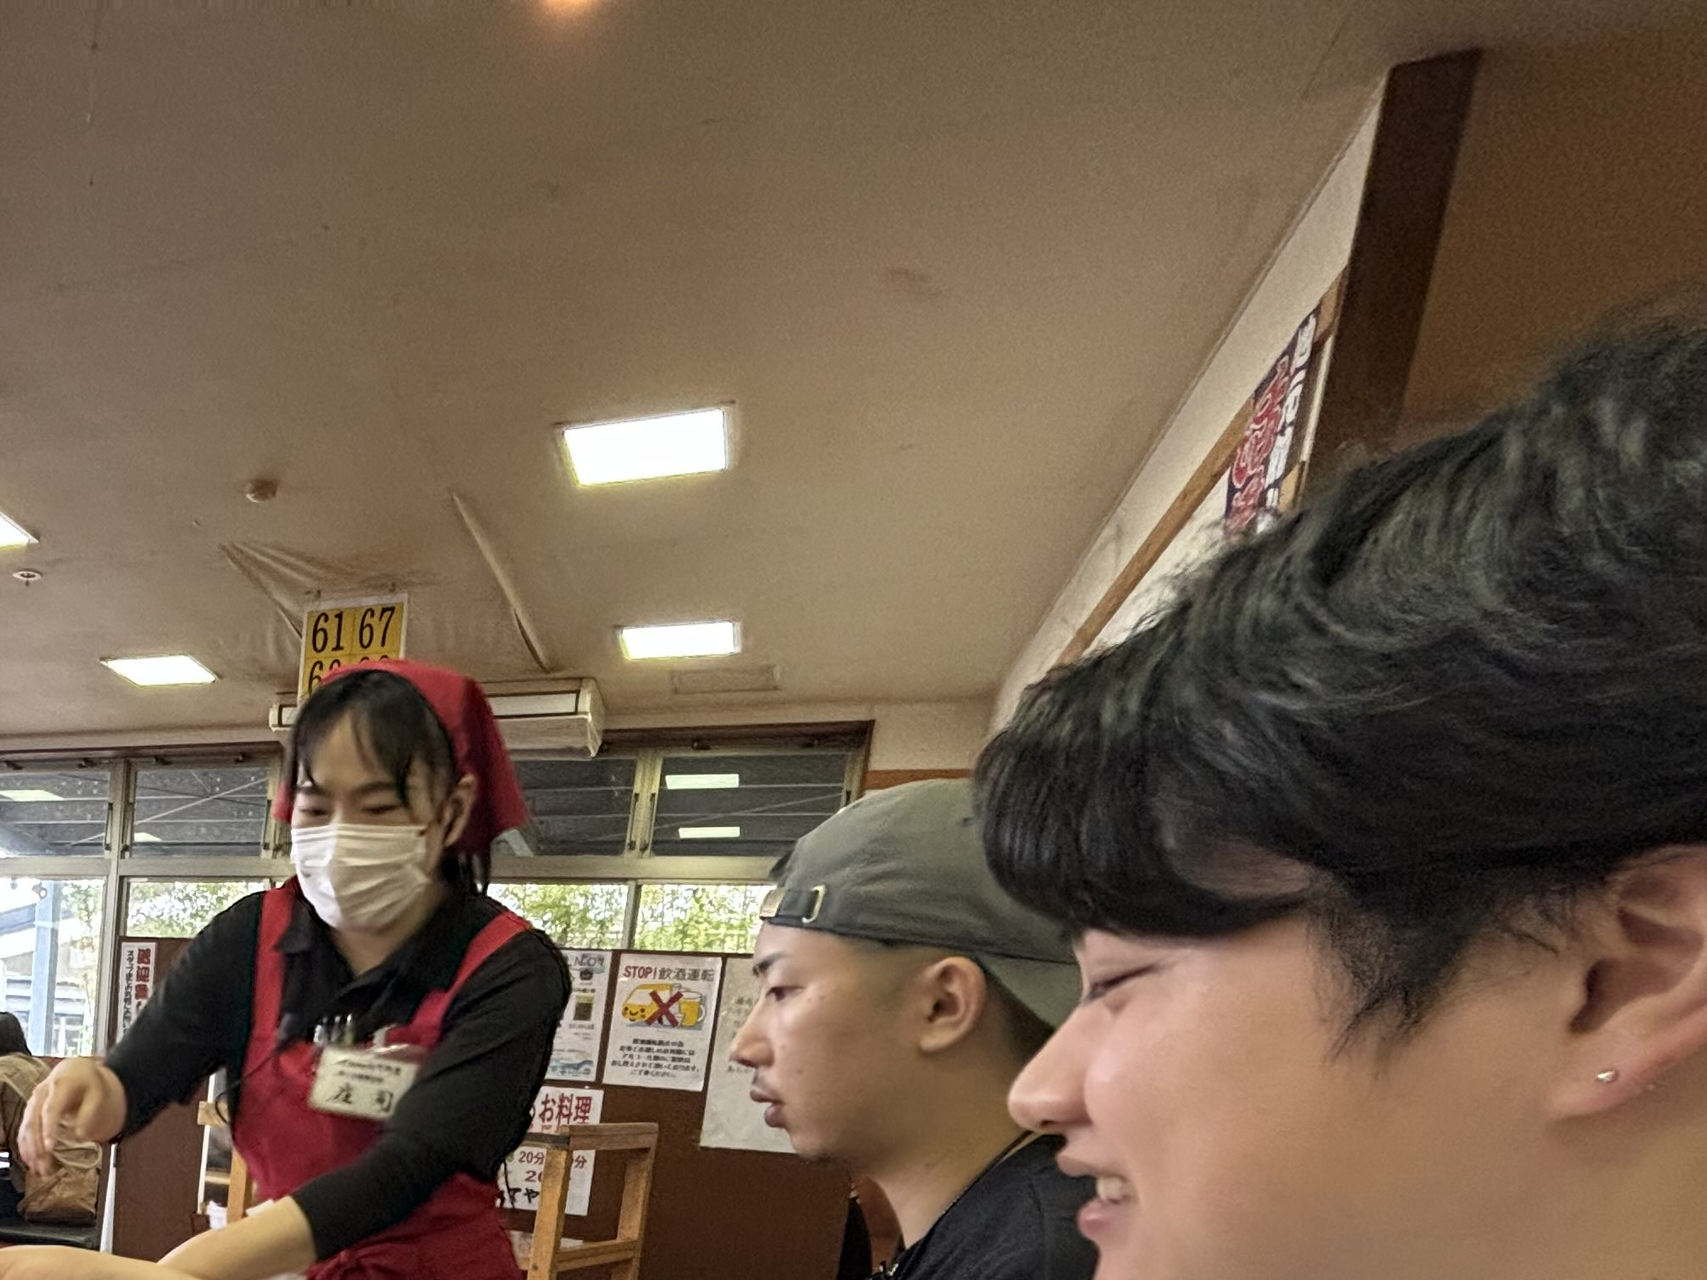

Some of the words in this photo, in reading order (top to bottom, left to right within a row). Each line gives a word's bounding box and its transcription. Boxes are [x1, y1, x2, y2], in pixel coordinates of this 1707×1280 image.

[312, 612, 344, 653] 61
[359, 606, 396, 649] 67
[308, 660, 341, 695] 6
